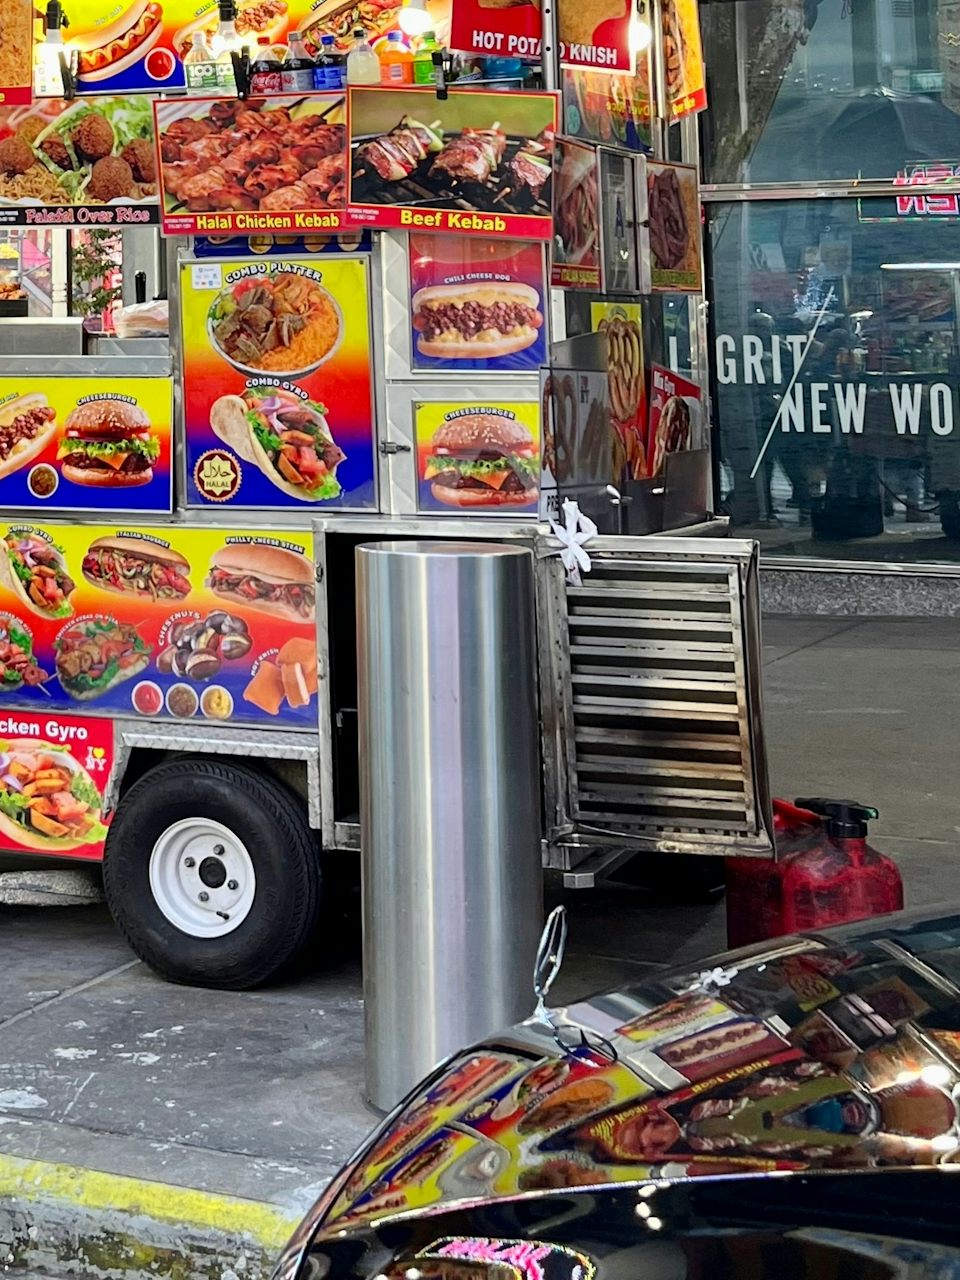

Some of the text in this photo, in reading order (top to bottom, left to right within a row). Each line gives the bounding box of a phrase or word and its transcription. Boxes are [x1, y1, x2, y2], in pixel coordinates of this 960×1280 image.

[471, 29, 617, 66] HOT POTA KNISH
[77, 207, 114, 223] Over
[117, 207, 151, 223] Rice
[196, 215, 233, 231] Halal
[236, 214, 292, 230] Chicken
[295, 213, 340, 228] Kebab
[400, 210, 442, 227] Beef
[447, 213, 507, 231] Kebab
[225, 262, 267, 284] COMBO
[270, 262, 323, 282] PLATTER
[444, 271, 511, 284] CHILI CHEESE DOG
[717, 333, 807, 385] GRIT
[245, 377, 309, 400] COMBO GYRO
[781, 382, 867, 435] NEW
[206, 480, 230, 488] HALAL
[8, 525, 54, 543] COMBO GYRO
[116, 530, 171, 548] ITALIAN SAUSAGE
[225, 535, 305, 554] PHILLY CHEESE STEAK
[158, 610, 201, 646] CHESTNUTS
[45, 720, 89, 741] Gyro
[85, 756, 107, 772] NY
